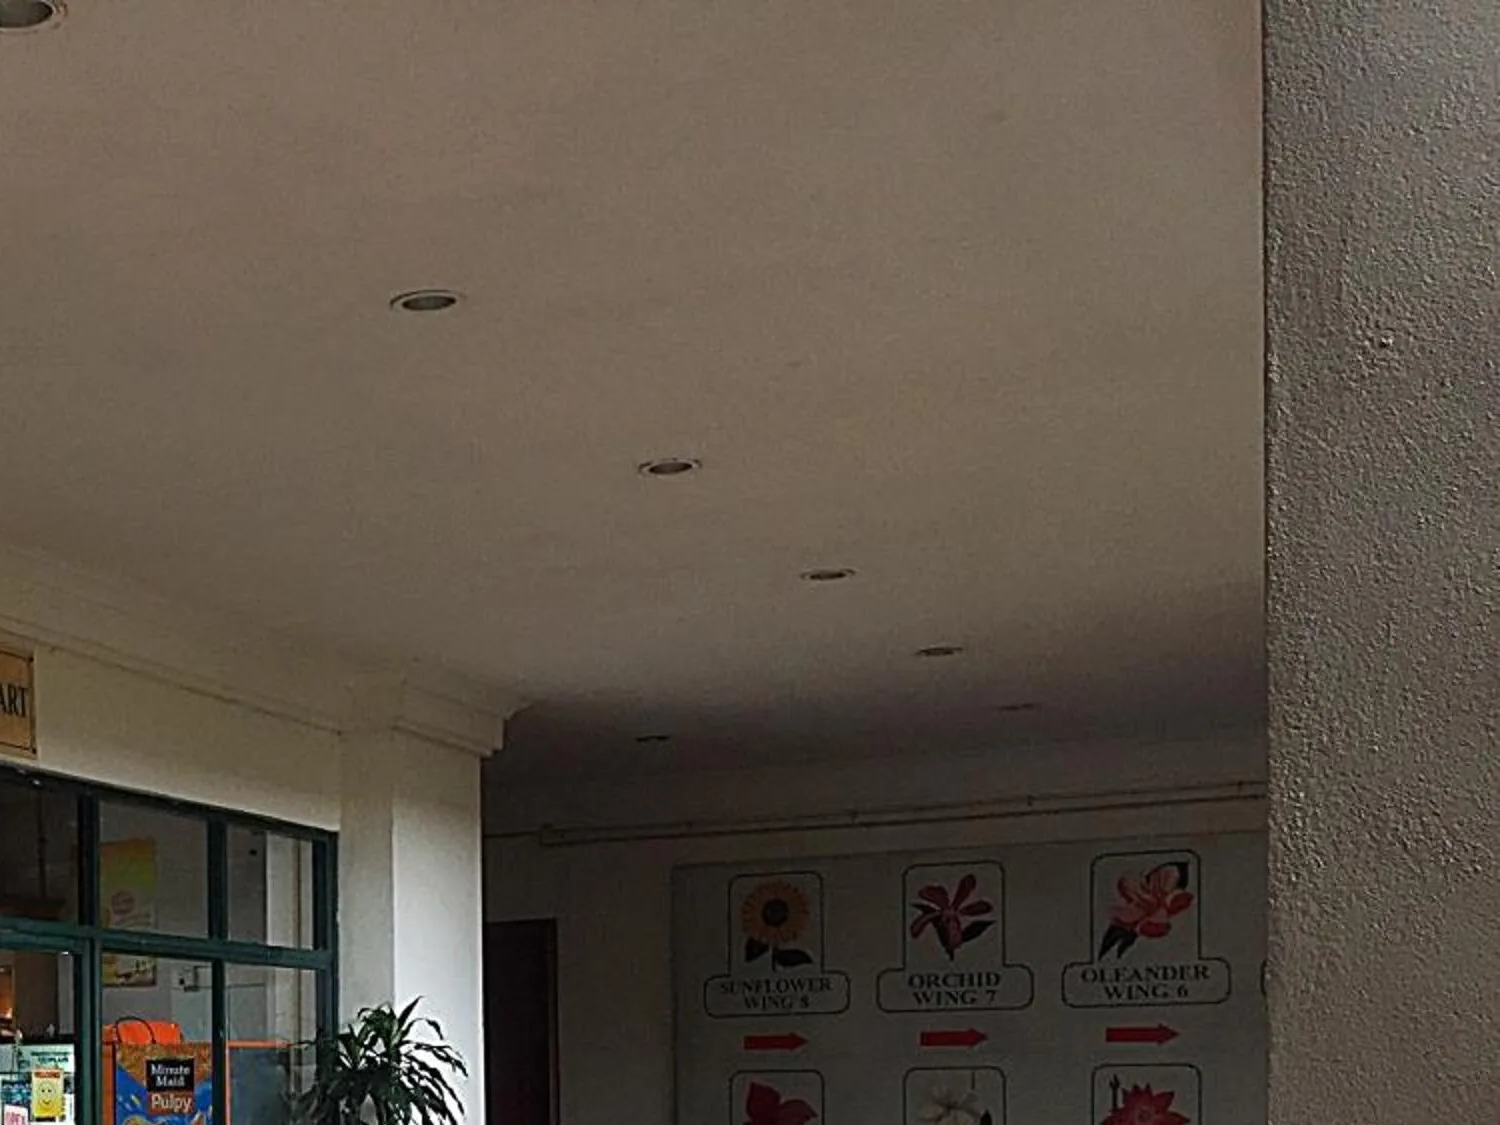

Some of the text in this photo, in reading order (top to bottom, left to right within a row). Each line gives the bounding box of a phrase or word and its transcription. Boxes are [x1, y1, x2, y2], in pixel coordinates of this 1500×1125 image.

[907, 970, 1002, 990] ORCHID
[1080, 963, 1211, 984] OLEANDER
[719, 977, 831, 995] SUNFLOWER
[1103, 982, 1189, 1001] WING 6
[743, 994, 793, 1010] WING
[912, 989, 998, 1007] WING 7
[151, 1062, 191, 1077] Minute
[155, 1076, 186, 1088] Maid
[151, 1092, 193, 1113] Pulpy
